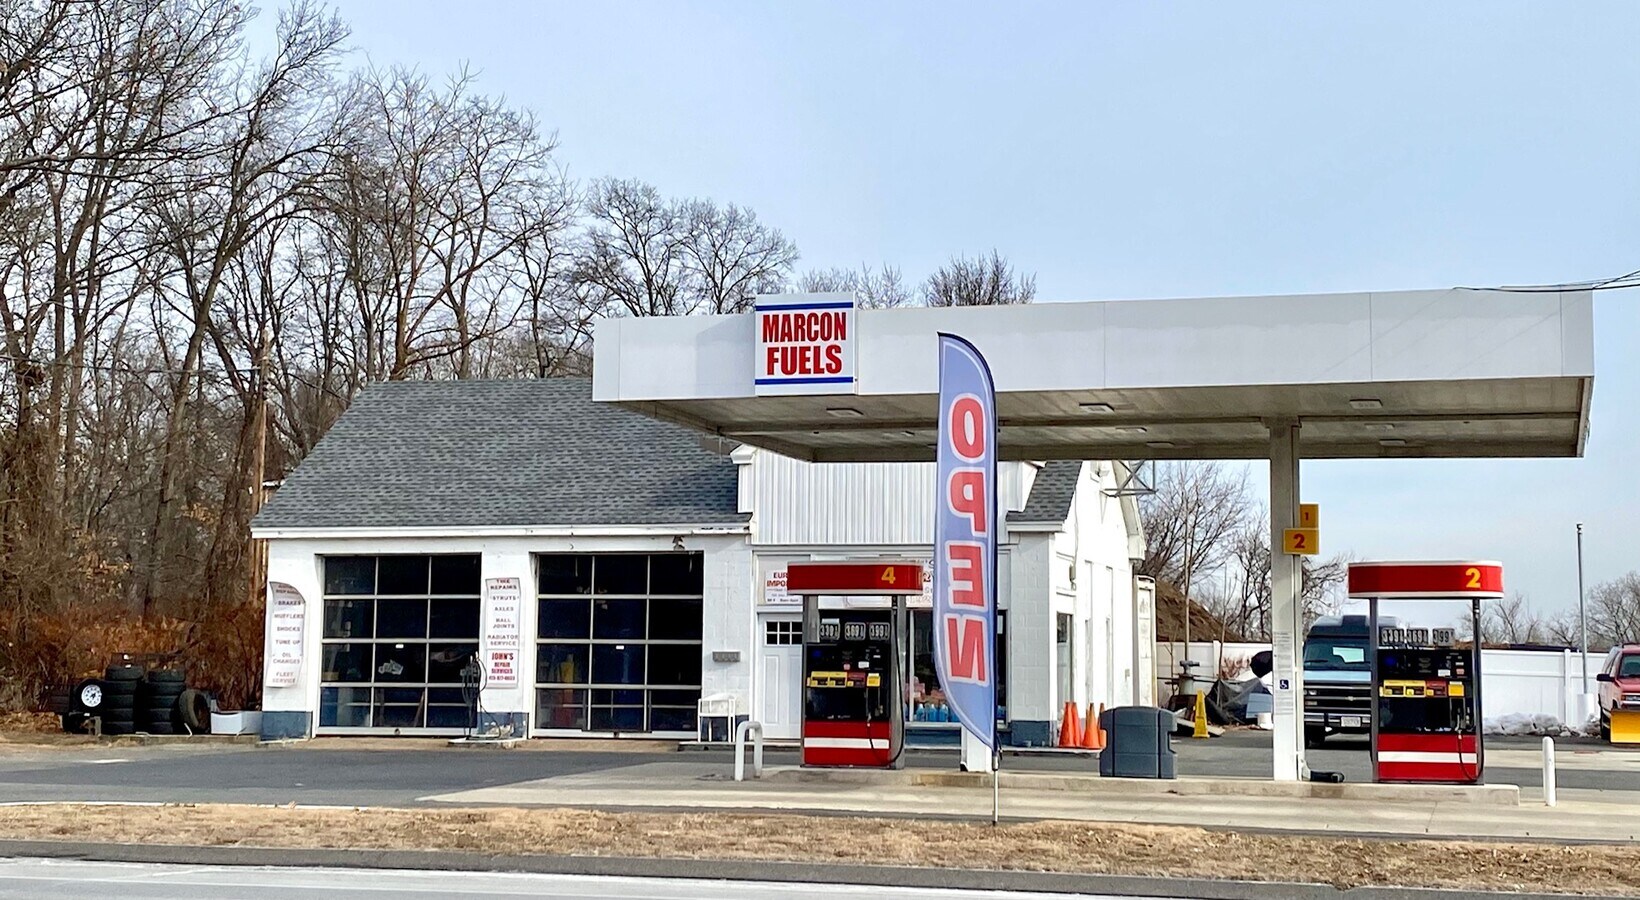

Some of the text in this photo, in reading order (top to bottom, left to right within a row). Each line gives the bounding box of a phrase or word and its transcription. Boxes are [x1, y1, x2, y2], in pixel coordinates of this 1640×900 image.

[763, 312, 846, 343] MARCON
[767, 344, 842, 375] FUELS
[1304, 512, 1309, 520] 1
[1293, 533, 1305, 549] 2
[881, 566, 896, 584] 4
[1465, 568, 1481, 588] 2
[492, 652, 514, 660] JOHN'S
